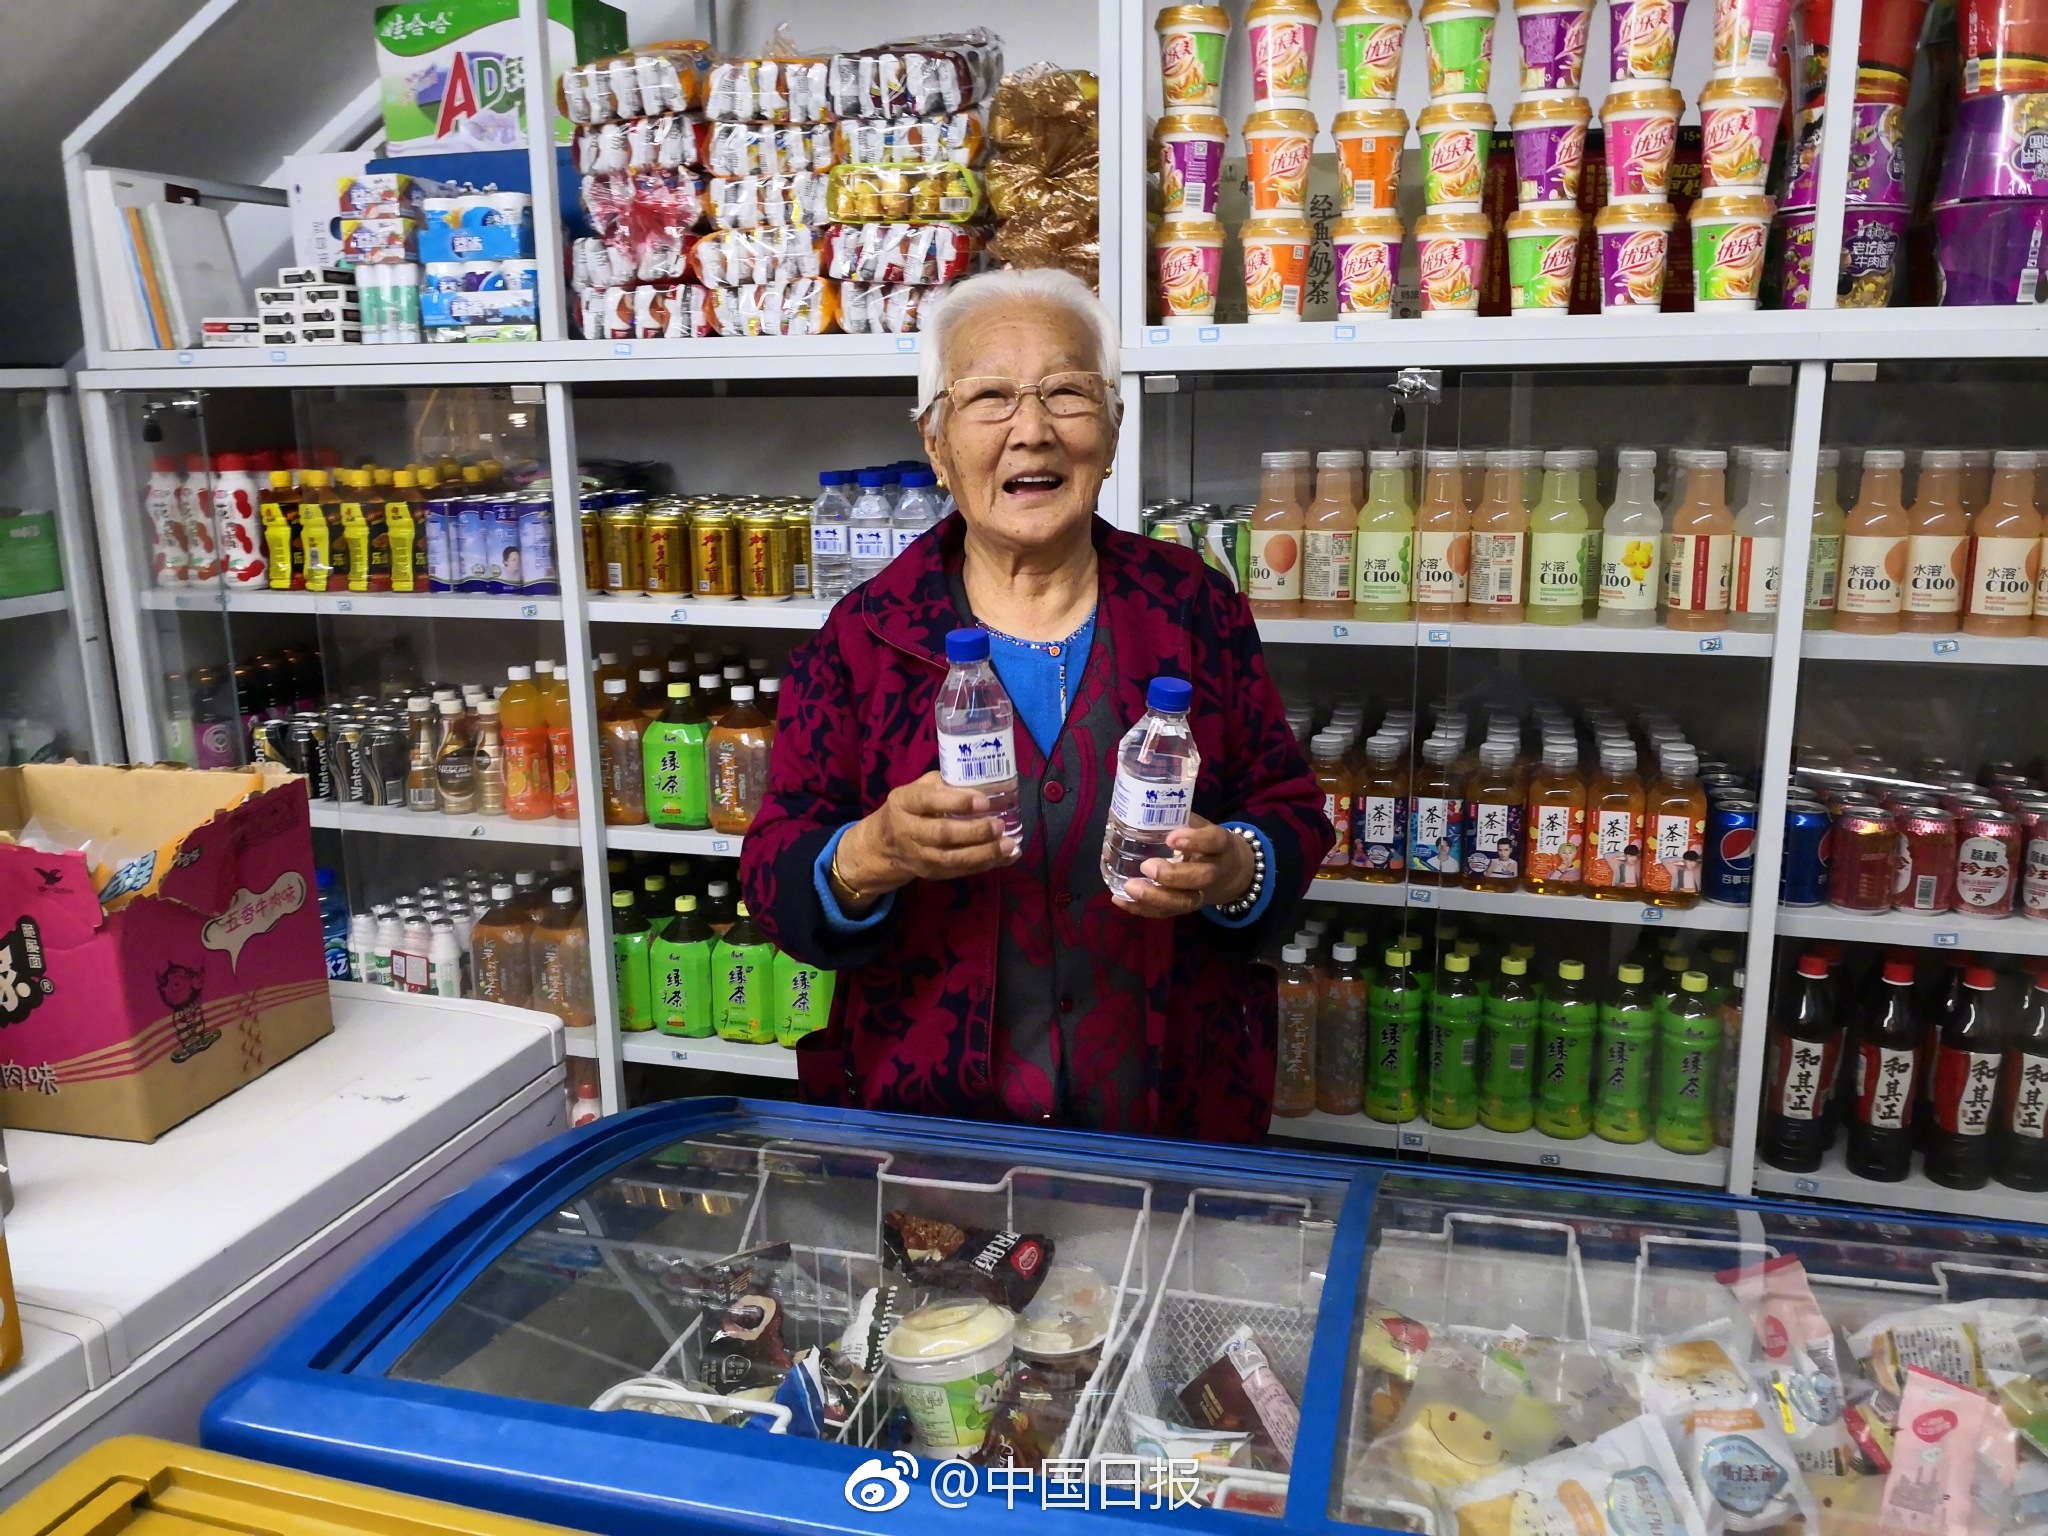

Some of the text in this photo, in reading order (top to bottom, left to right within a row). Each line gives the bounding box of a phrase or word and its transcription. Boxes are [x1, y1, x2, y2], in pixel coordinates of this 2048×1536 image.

[379, 12, 453, 41] 娃哈哈
[1706, 115, 1750, 145] 优乐美
[1431, 137, 1474, 166] 优乐美
[1306, 194, 1341, 305] 经典奶茶
[1344, 249, 1386, 276] 优乐美
[1421, 246, 1461, 273] 优乐美
[1619, 239, 1664, 268] 优乐美
[1717, 231, 1763, 262] 优乐美
[1854, 254, 1890, 269] 牛肉面
[1162, 253, 1199, 279] 优乐美
[1363, 570, 1400, 583] C100
[1364, 558, 1387, 571] 水溶
[1416, 570, 1453, 584] C100
[1539, 572, 1578, 585] C100
[1540, 561, 1566, 573] 水溶
[1848, 565, 1876, 578] 水溶
[1913, 564, 1942, 577] 水溶
[1986, 567, 2016, 580] 水溶
[1847, 577, 1891, 591] C100
[1912, 577, 1955, 590] C100
[1985, 580, 2029, 593] C100
[315, 740, 331, 797] Watson's
[347, 742, 364, 800] Watson's
[660, 750, 681, 794] 绿茶
[1371, 803, 1389, 837] 茶π
[1424, 805, 1442, 838] 茶π
[1483, 811, 1501, 845] 茶π
[1545, 813, 1562, 846] 茶π
[1605, 818, 1624, 852] 茶π
[1664, 823, 1683, 857] 茶π
[1959, 861, 2008, 879] 珍珍
[226, 884, 297, 934] 五香牛肉味
[666, 968, 684, 1009] 绿茶
[728, 965, 747, 1006] 绿茶
[791, 970, 811, 1013] 绿茶
[1380, 1022, 1401, 1072] 绿茶
[1548, 1036, 1568, 1086] 绿茶
[1607, 1041, 1629, 1089] 绿茶
[1680, 1051, 1703, 1098] 绿茶
[1789, 1047, 1821, 1112] 和其正
[1878, 1056, 1911, 1121] 和其正
[1963, 1059, 1997, 1126] 和其正
[2018, 1063, 2048, 1130] 和其正
